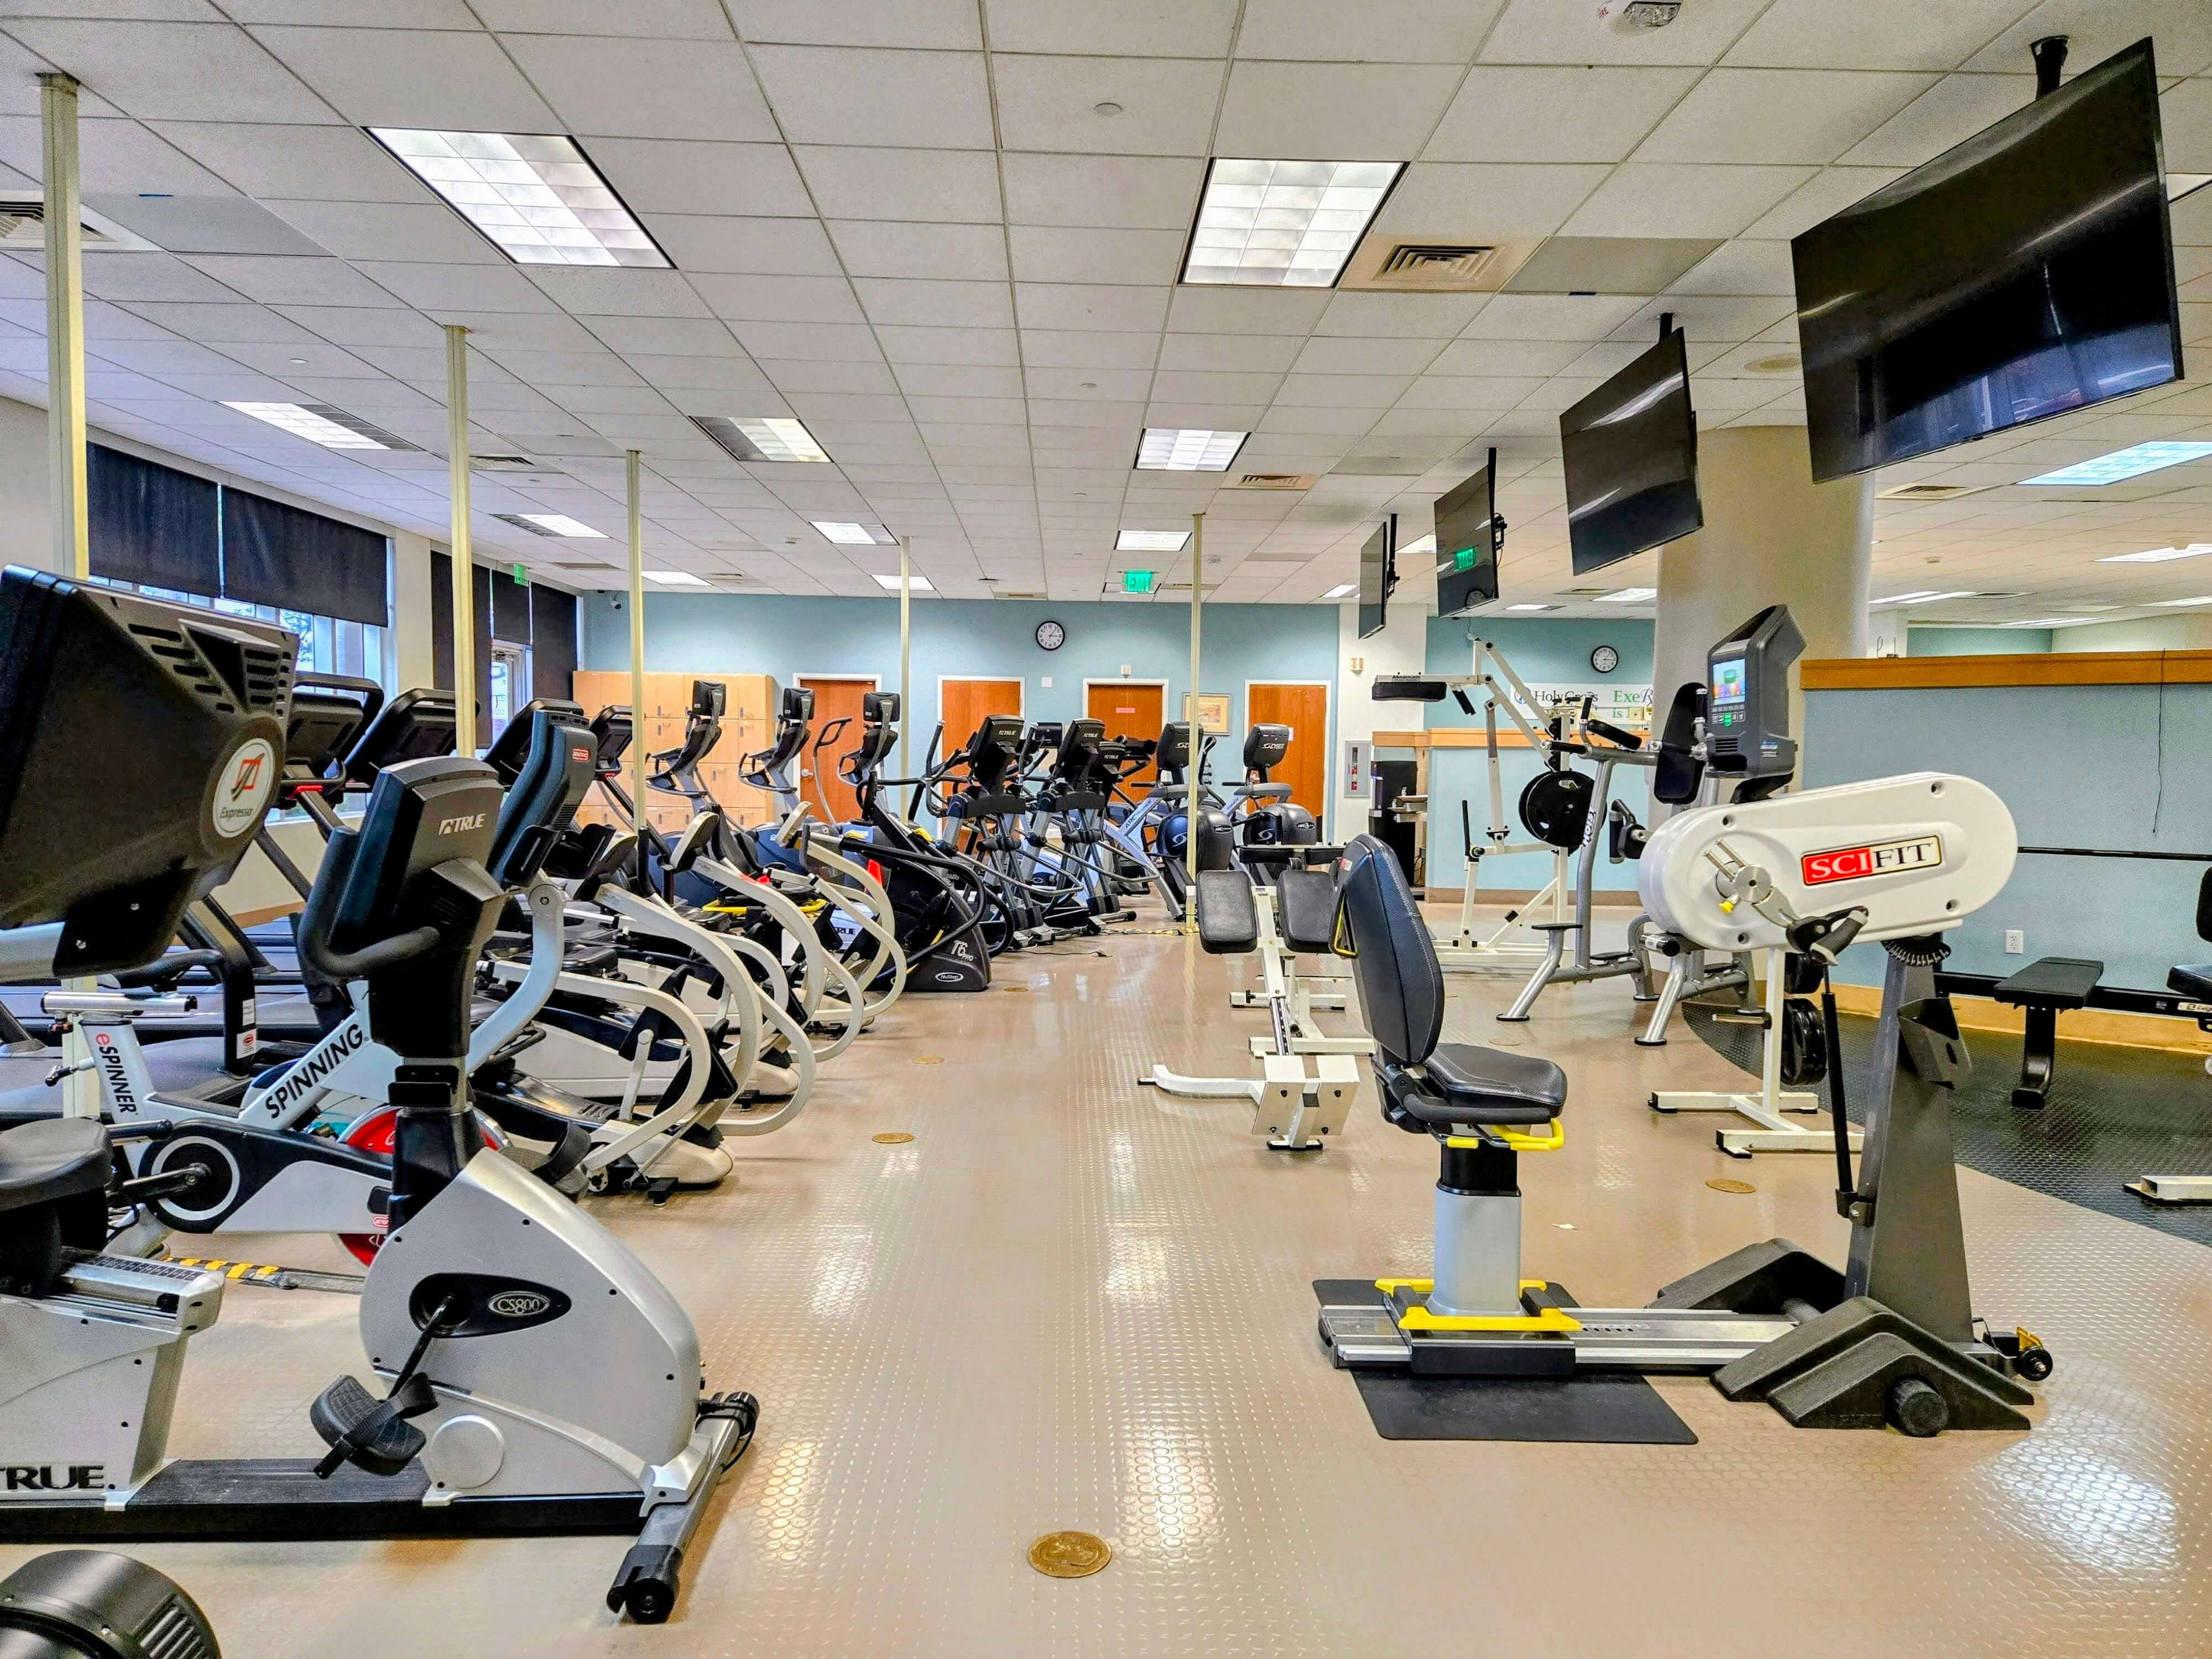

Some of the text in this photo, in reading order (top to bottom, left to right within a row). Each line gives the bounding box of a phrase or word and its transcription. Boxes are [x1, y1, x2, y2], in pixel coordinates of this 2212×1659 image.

[1128, 572, 1151, 592] EXIT
[453, 813, 487, 833] TRUE
[1811, 841, 1934, 879] SCIFIT
[834, 926, 856, 936] RUE
[951, 940, 968, 957] T6
[264, 1024, 363, 1119] SPINNING
[497, 1298, 540, 1314] CS800
[0, 1465, 105, 1490] RUE
